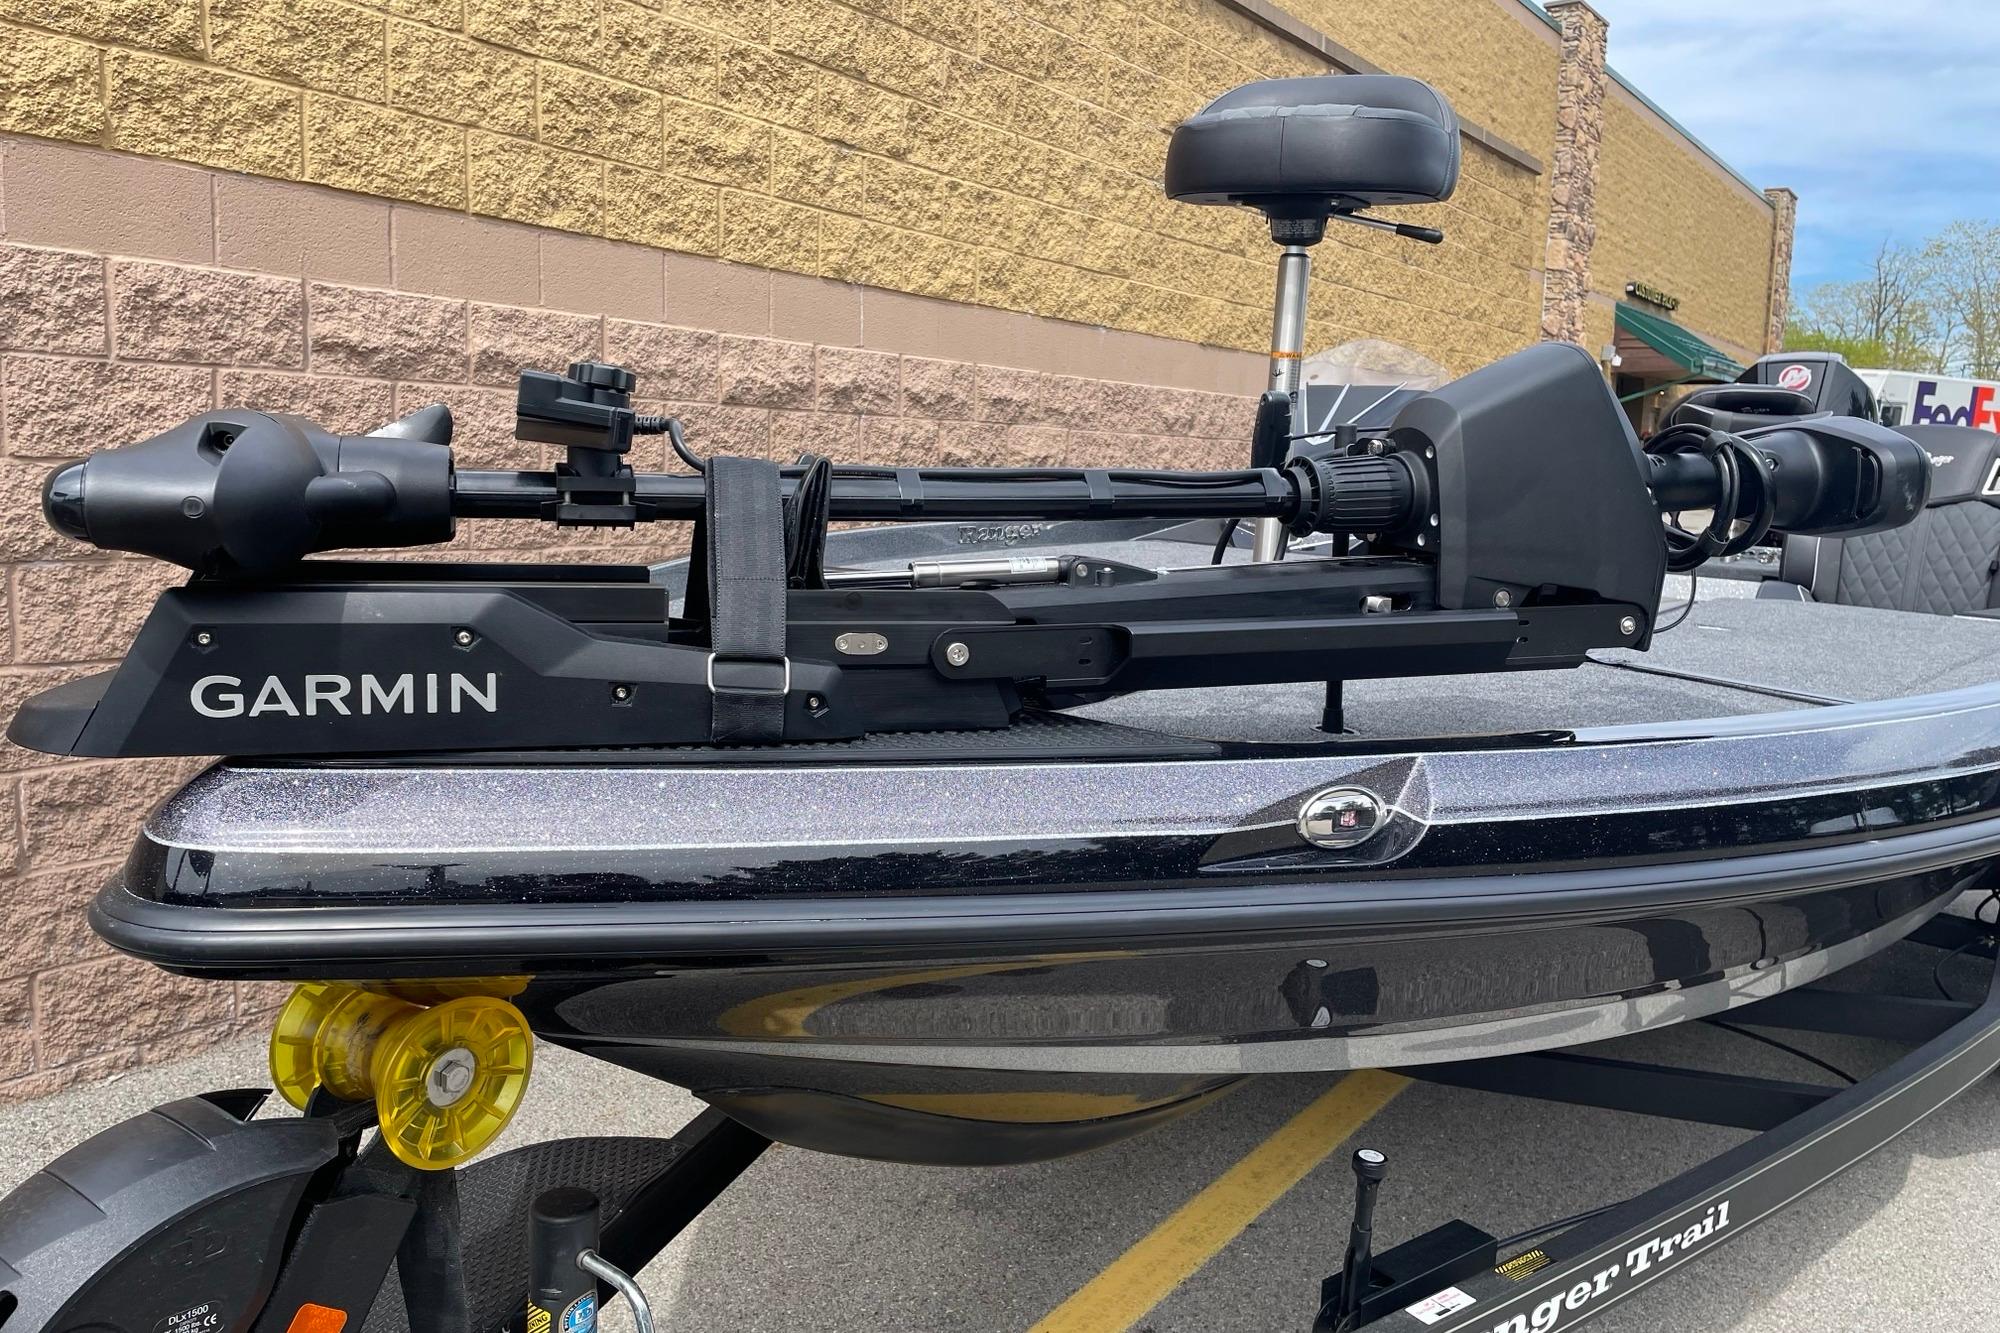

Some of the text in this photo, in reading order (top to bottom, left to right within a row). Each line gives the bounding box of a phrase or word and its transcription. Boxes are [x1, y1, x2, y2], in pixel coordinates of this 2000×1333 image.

[1911, 380, 2000, 434] FedE
[958, 523, 1043, 546] Ranger
[190, 672, 497, 718] GARMIN
[1625, 1199, 1730, 1278] Trail
[168, 1304, 209, 1326] DLx1500
